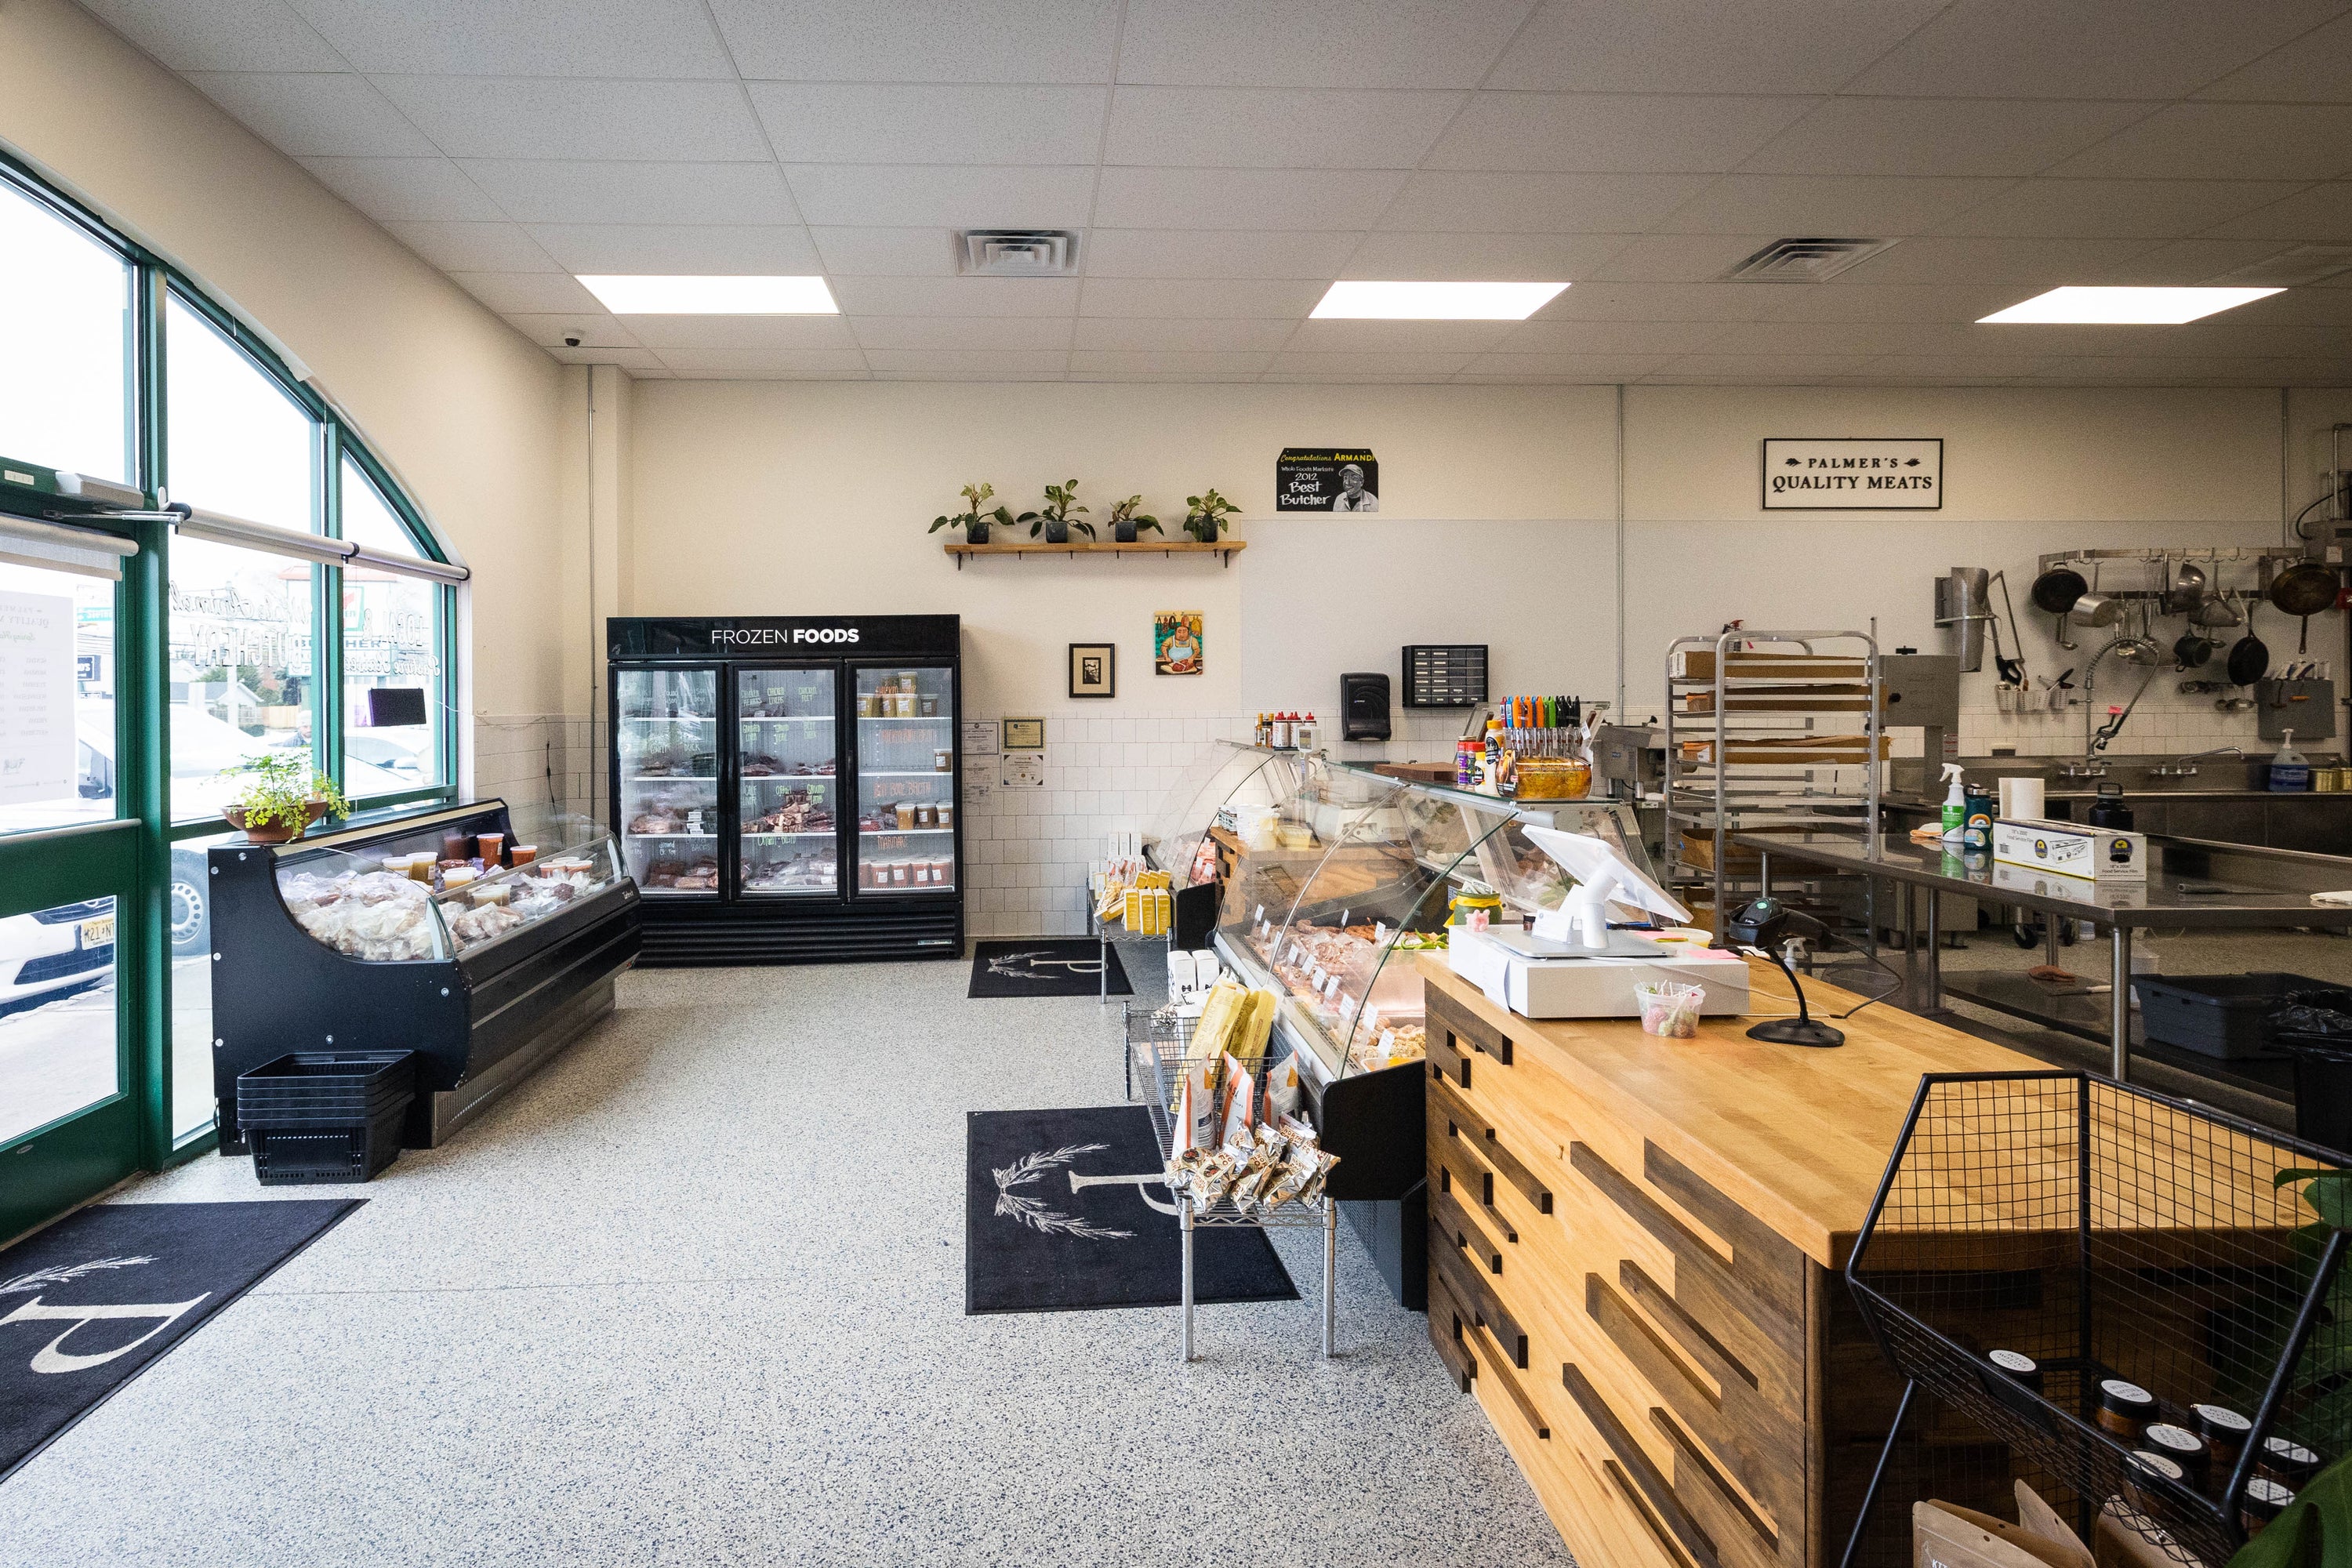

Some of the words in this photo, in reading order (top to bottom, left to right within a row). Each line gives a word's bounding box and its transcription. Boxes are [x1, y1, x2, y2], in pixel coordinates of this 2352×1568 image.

[1280, 454, 1332, 463] Congratulations
[1808, 458, 1898, 469] PALMER'S
[1288, 481, 1323, 493] Best
[1773, 476, 1860, 493] QUALITY
[1867, 476, 1933, 489] MEATS
[1279, 494, 1331, 506] Butcher
[712, 630, 787, 644] FROZEN
[793, 629, 859, 644] FOODS
[1283, 1128, 1302, 1142] NORTH
